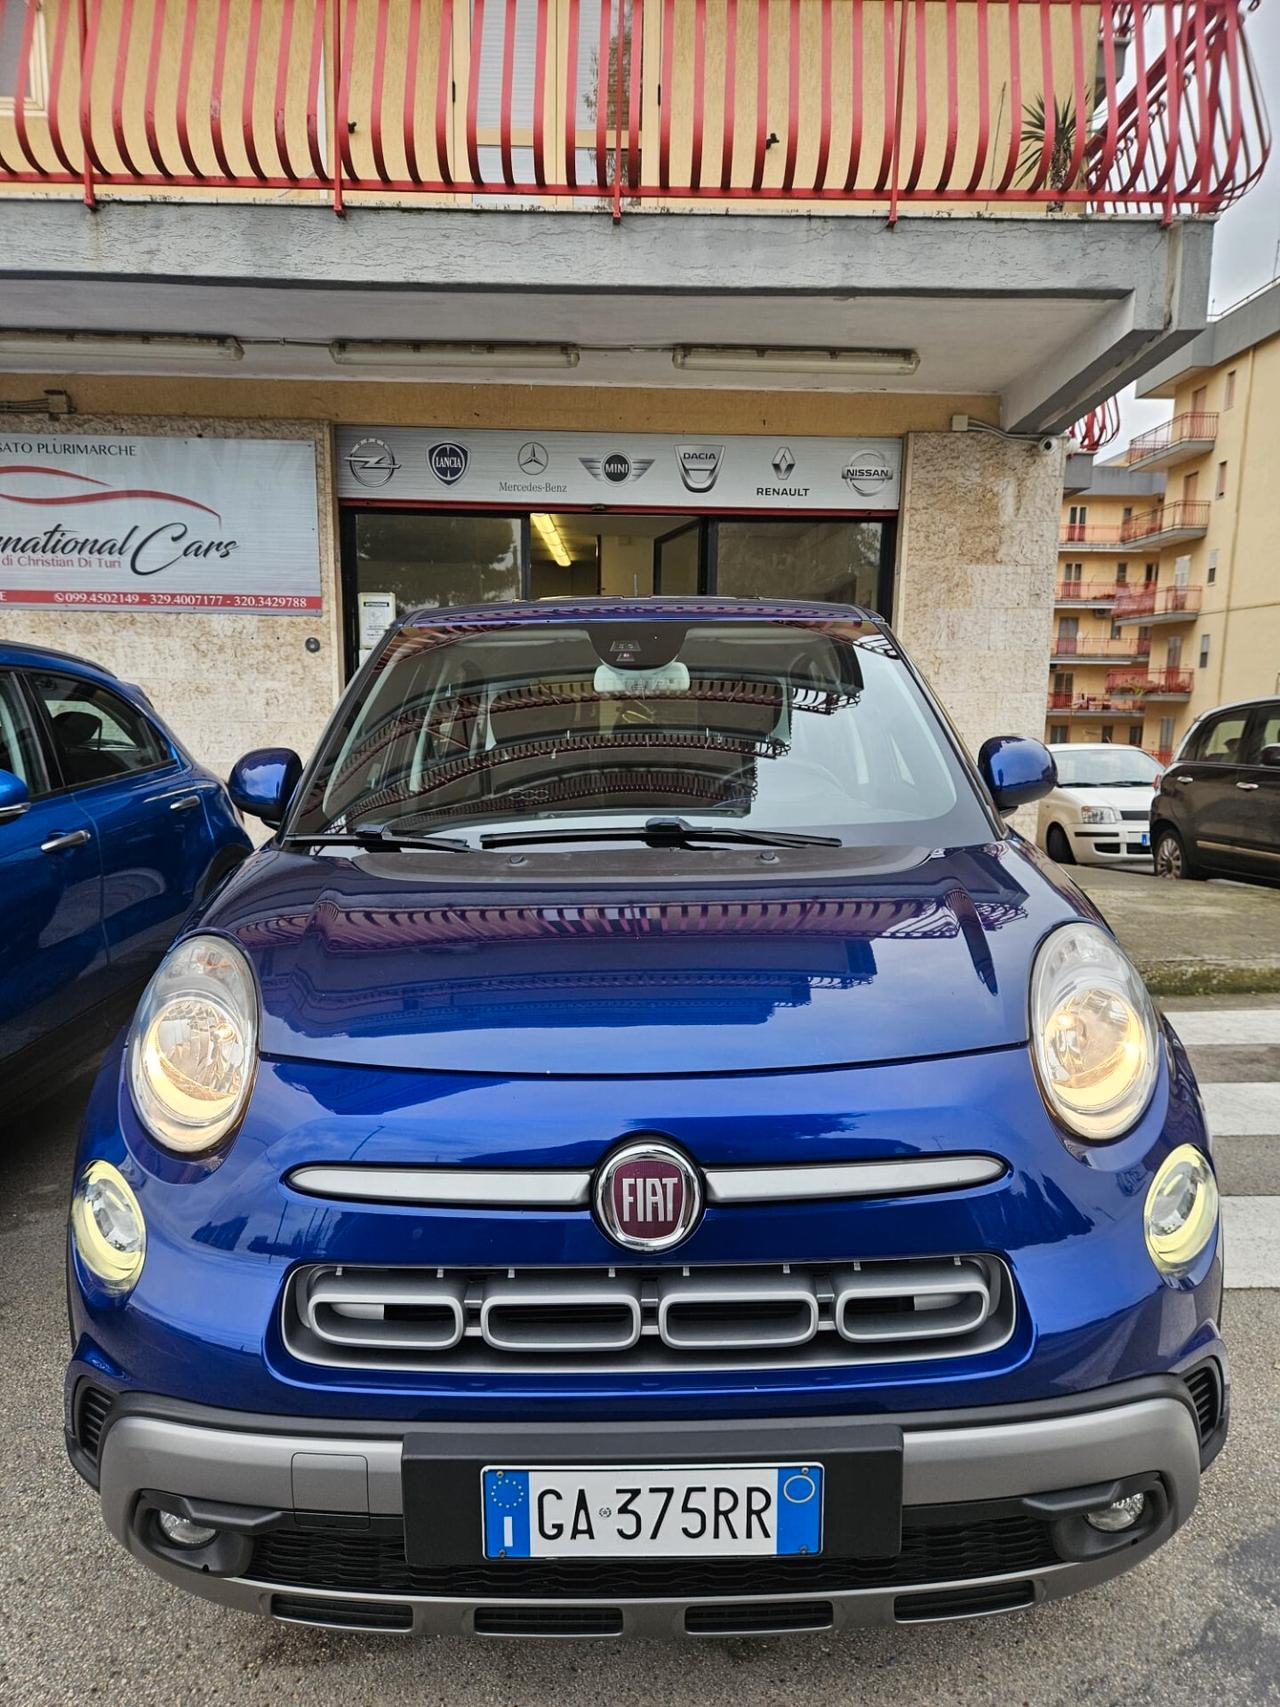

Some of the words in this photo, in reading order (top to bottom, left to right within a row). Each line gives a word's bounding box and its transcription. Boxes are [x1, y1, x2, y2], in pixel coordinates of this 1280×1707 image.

[37, 443, 136, 456] PLURIMARCHE
[435, 456, 462, 468] LANCIA
[683, 452, 716, 462] DACIA
[605, 463, 628, 474] MINI
[846, 468, 889, 478] NISSAN
[499, 481, 568, 493] Mercedes-Benz
[756, 487, 810, 497] RENAULT
[130, 522, 240, 576] Cars
[1, 554, 14, 567] di
[17, 556, 75, 568] Christian
[78, 557, 92, 568] Di
[97, 557, 122, 569] Turi
[65, 592, 140, 604] 099.4502149
[150, 594, 223, 606] 329.4007177
[234, 595, 307, 608] 320.3429788
[621, 1177, 679, 1222] FIAT
[536, 1487, 596, 1541] GA
[615, 1486, 772, 1540] 375RR
